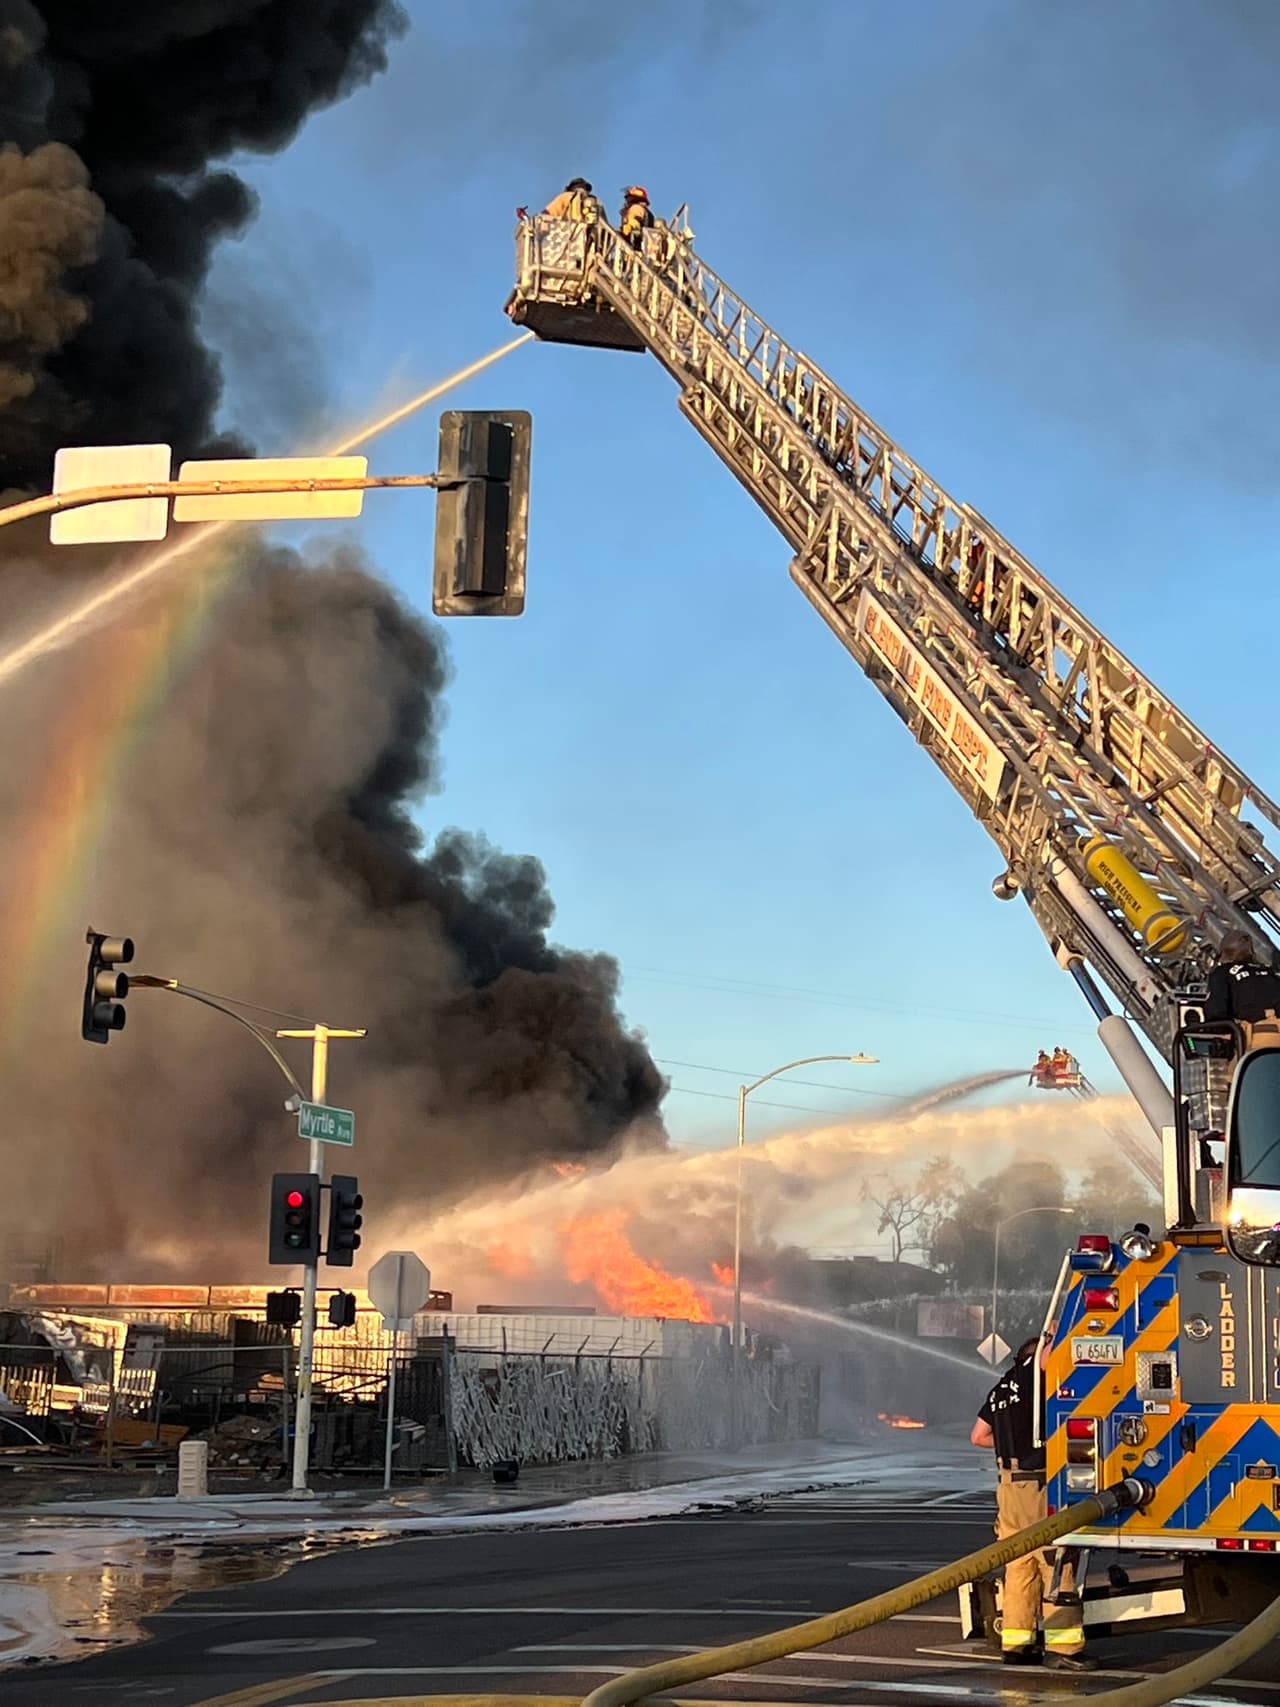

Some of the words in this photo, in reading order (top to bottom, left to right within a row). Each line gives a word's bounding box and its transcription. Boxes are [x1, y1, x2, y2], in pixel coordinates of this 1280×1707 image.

[921, 675, 953, 732] FIRE
[302, 1108, 335, 1136] Myrtle
[1088, 1344, 1118, 1360] 654FV
[1219, 1282, 1236, 1388] LADDER
